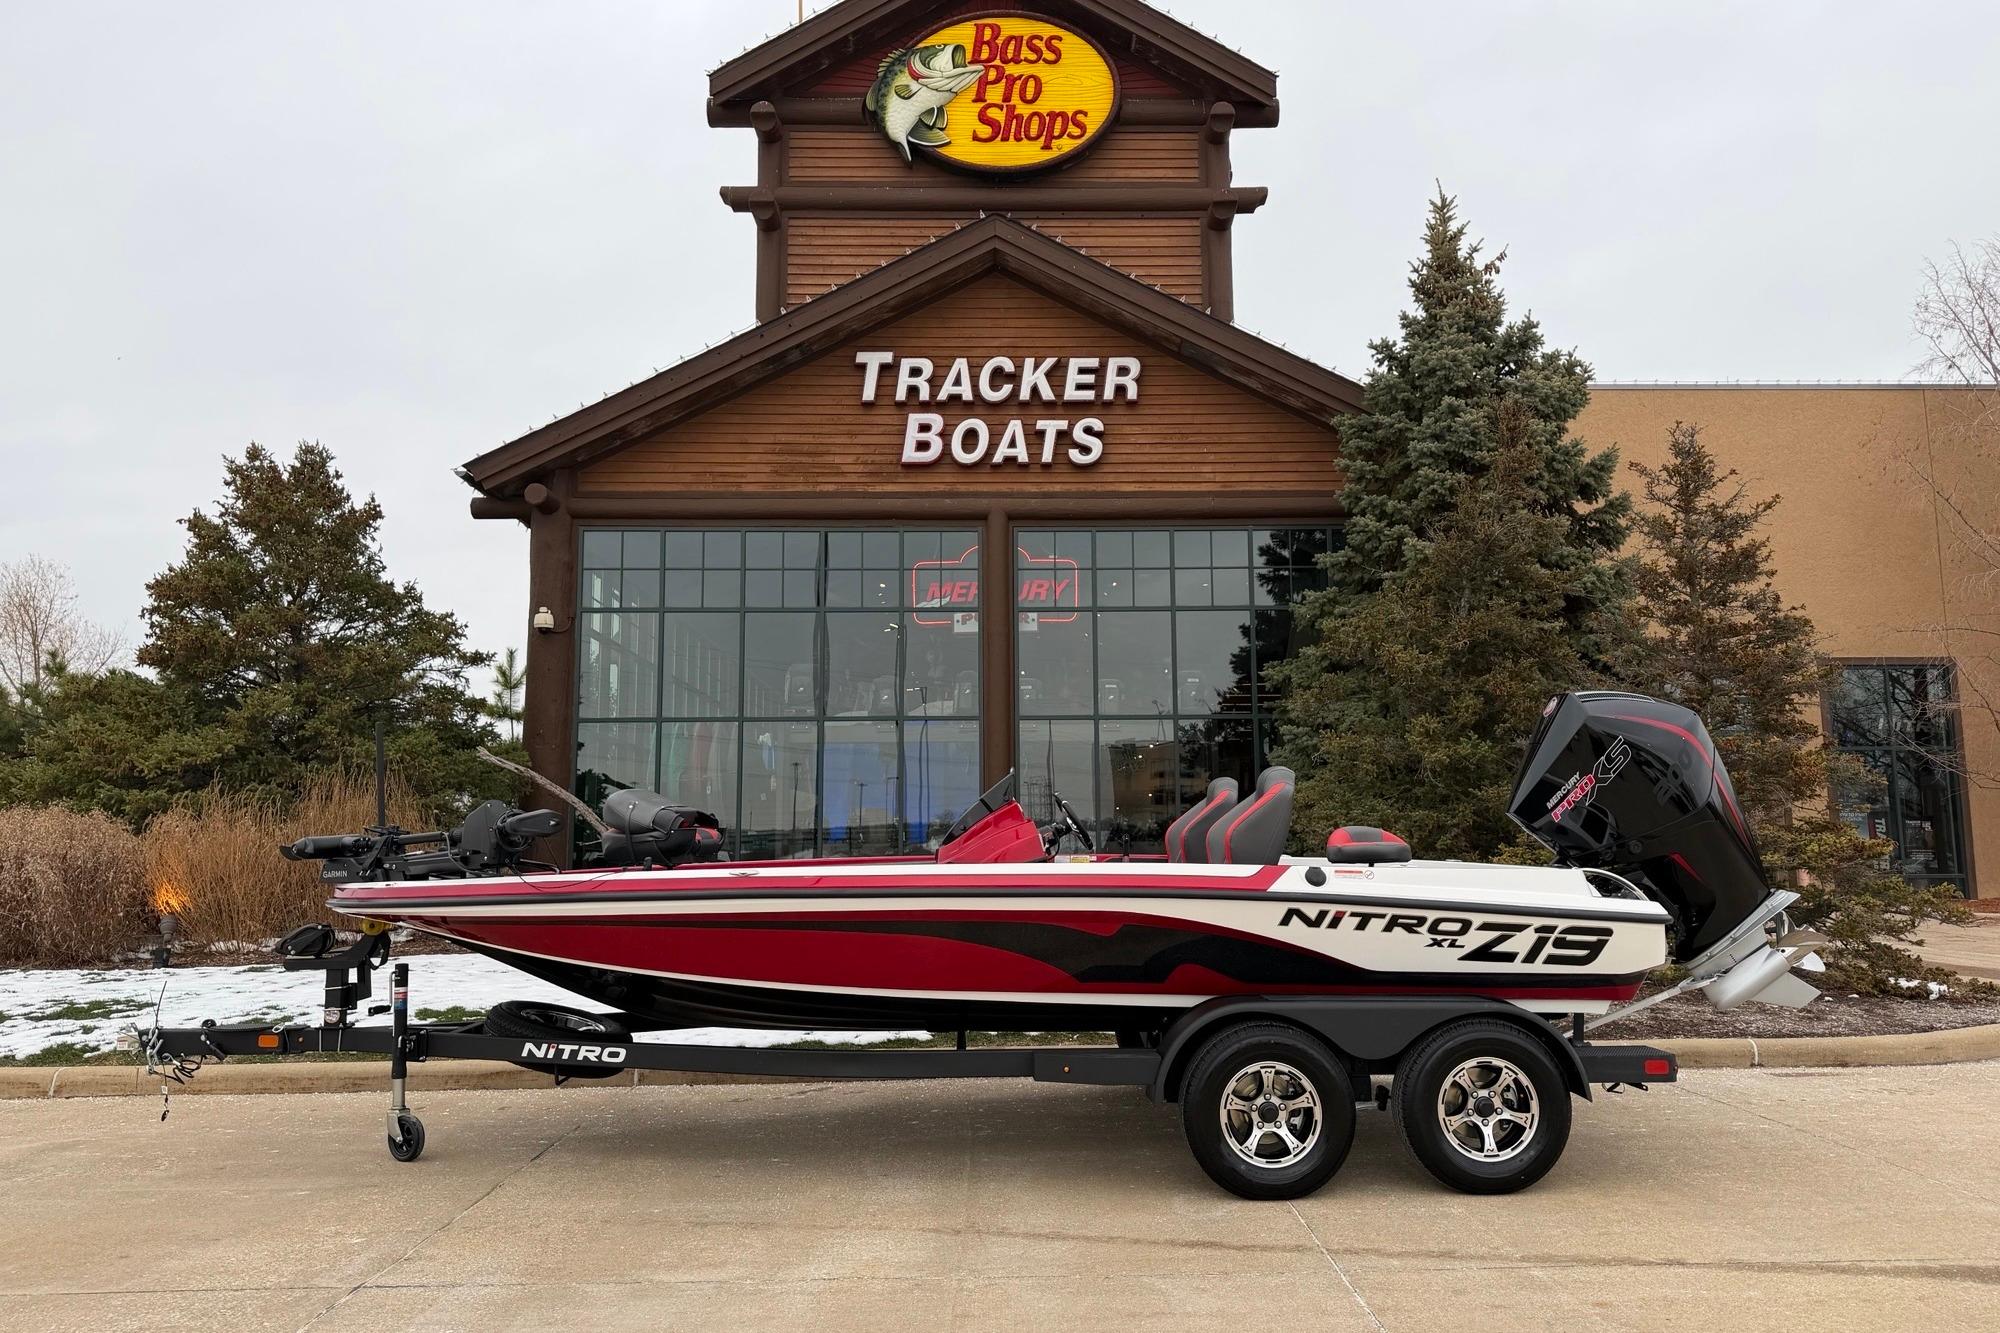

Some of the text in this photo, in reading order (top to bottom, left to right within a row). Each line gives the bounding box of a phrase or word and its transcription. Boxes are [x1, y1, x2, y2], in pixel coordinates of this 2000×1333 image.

[968, 22, 1063, 65] Bass
[971, 64, 1043, 104] Pro
[972, 103, 1089, 150] Shops
[854, 350, 1142, 404] TRACKER
[901, 412, 1106, 467] BOATS
[1546, 771, 1580, 810] MERCURY
[322, 870, 348, 878] GARMIN
[1423, 937, 1466, 949] XL
[1456, 919, 1614, 966] Z19
